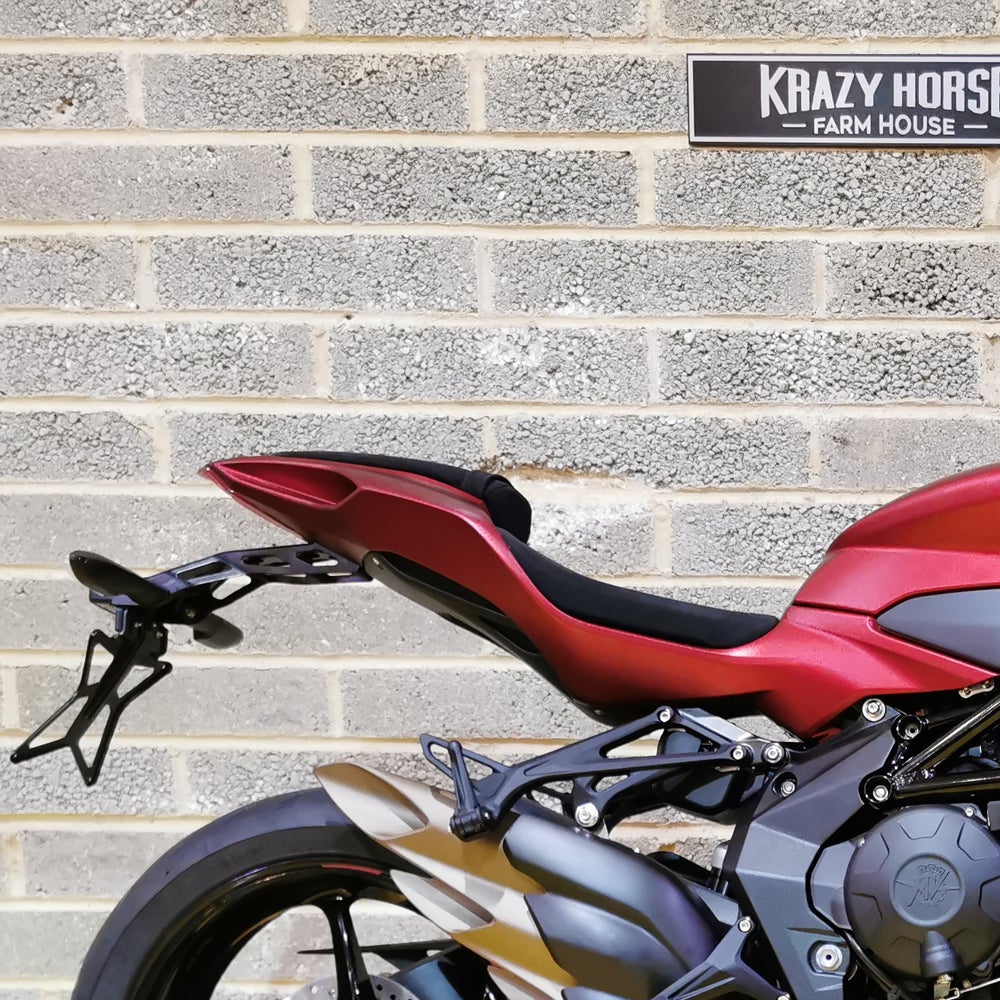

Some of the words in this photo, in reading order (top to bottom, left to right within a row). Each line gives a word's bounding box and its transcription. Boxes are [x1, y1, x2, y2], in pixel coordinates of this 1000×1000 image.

[760, 64, 883, 118] KRAZY
[813, 117, 872, 134] FARM
[878, 114, 956, 136] HOUSE
